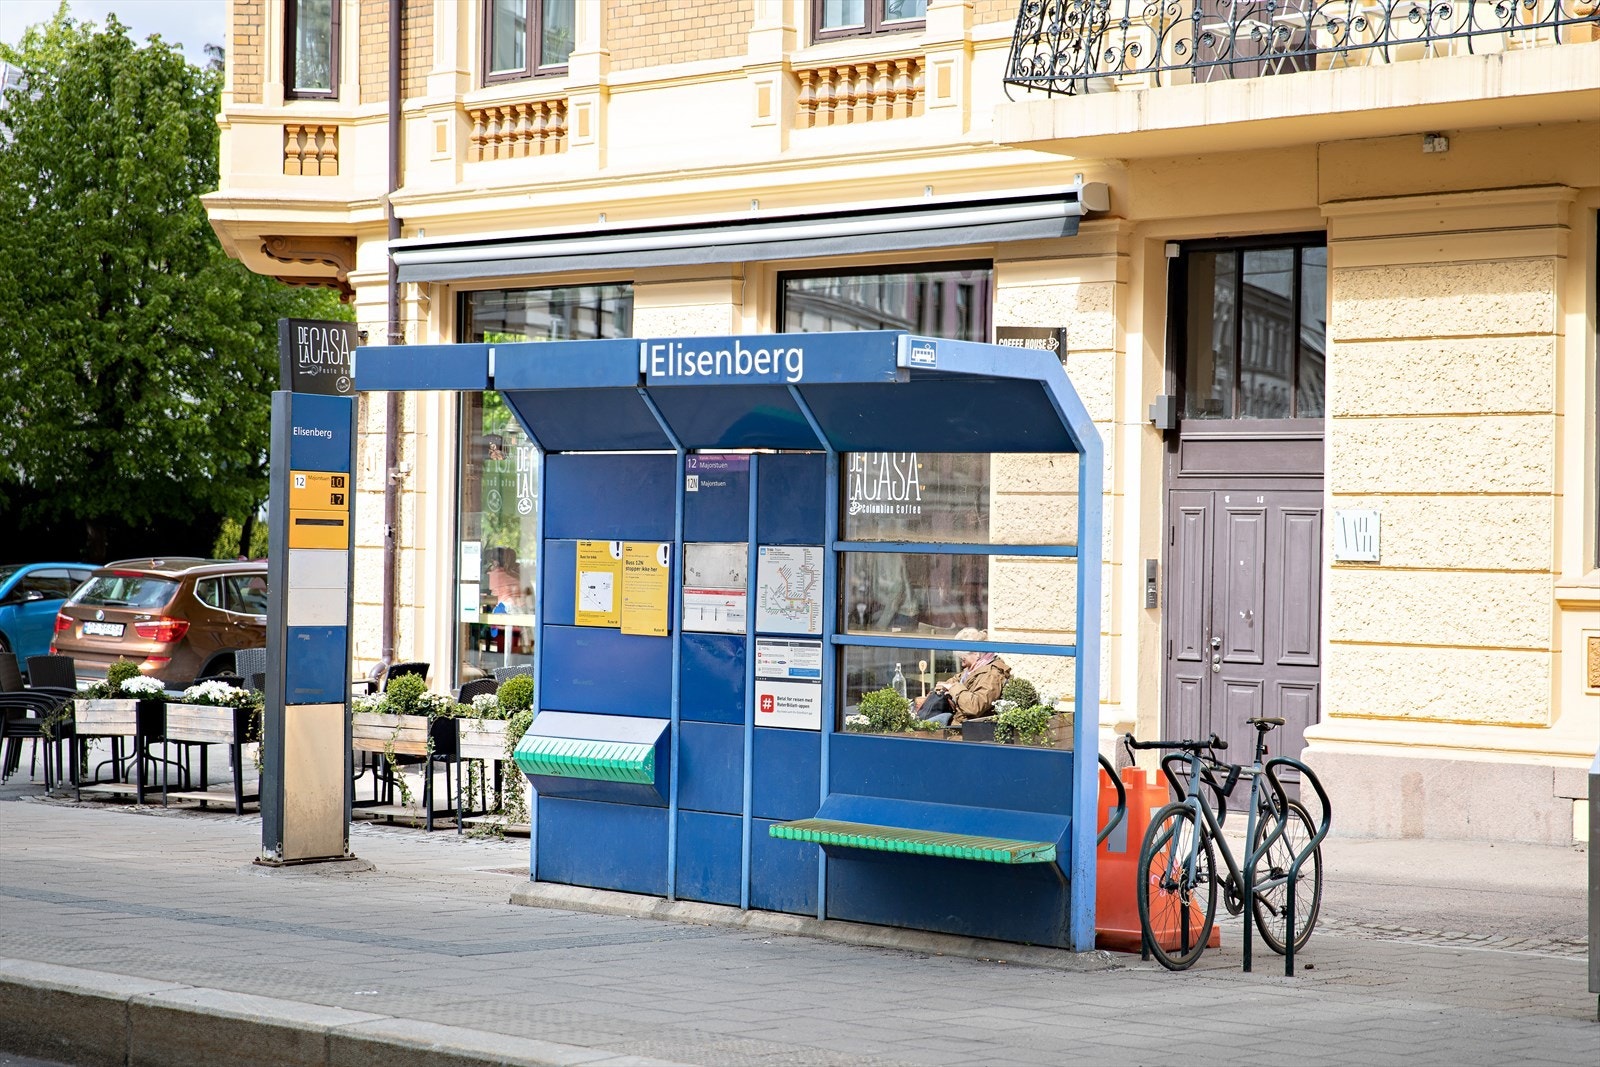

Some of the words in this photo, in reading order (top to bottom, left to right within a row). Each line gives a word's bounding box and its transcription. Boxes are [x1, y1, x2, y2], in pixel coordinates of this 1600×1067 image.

[297, 326, 309, 345] DE
[309, 326, 351, 366] CASA
[998, 338, 1024, 348] COFFEE
[1024, 338, 1047, 350] HOUSE
[299, 345, 311, 364] LA
[650, 340, 804, 383] Elisenberg
[293, 426, 332, 440] Elisenberg
[516, 446, 529, 472] DE
[687, 458, 697, 469] 12
[699, 461, 728, 470] Majorstuen
[295, 477, 305, 487] 12
[331, 477, 343, 488] 10
[687, 478, 698, 489] 12N
[700, 480, 727, 488] Majorstuen
[863, 452, 922, 501] CASA
[516, 473, 530, 498] LA
[849, 474, 863, 501] LA
[331, 494, 343, 505] 17
[896, 504, 921, 515] Coffee
